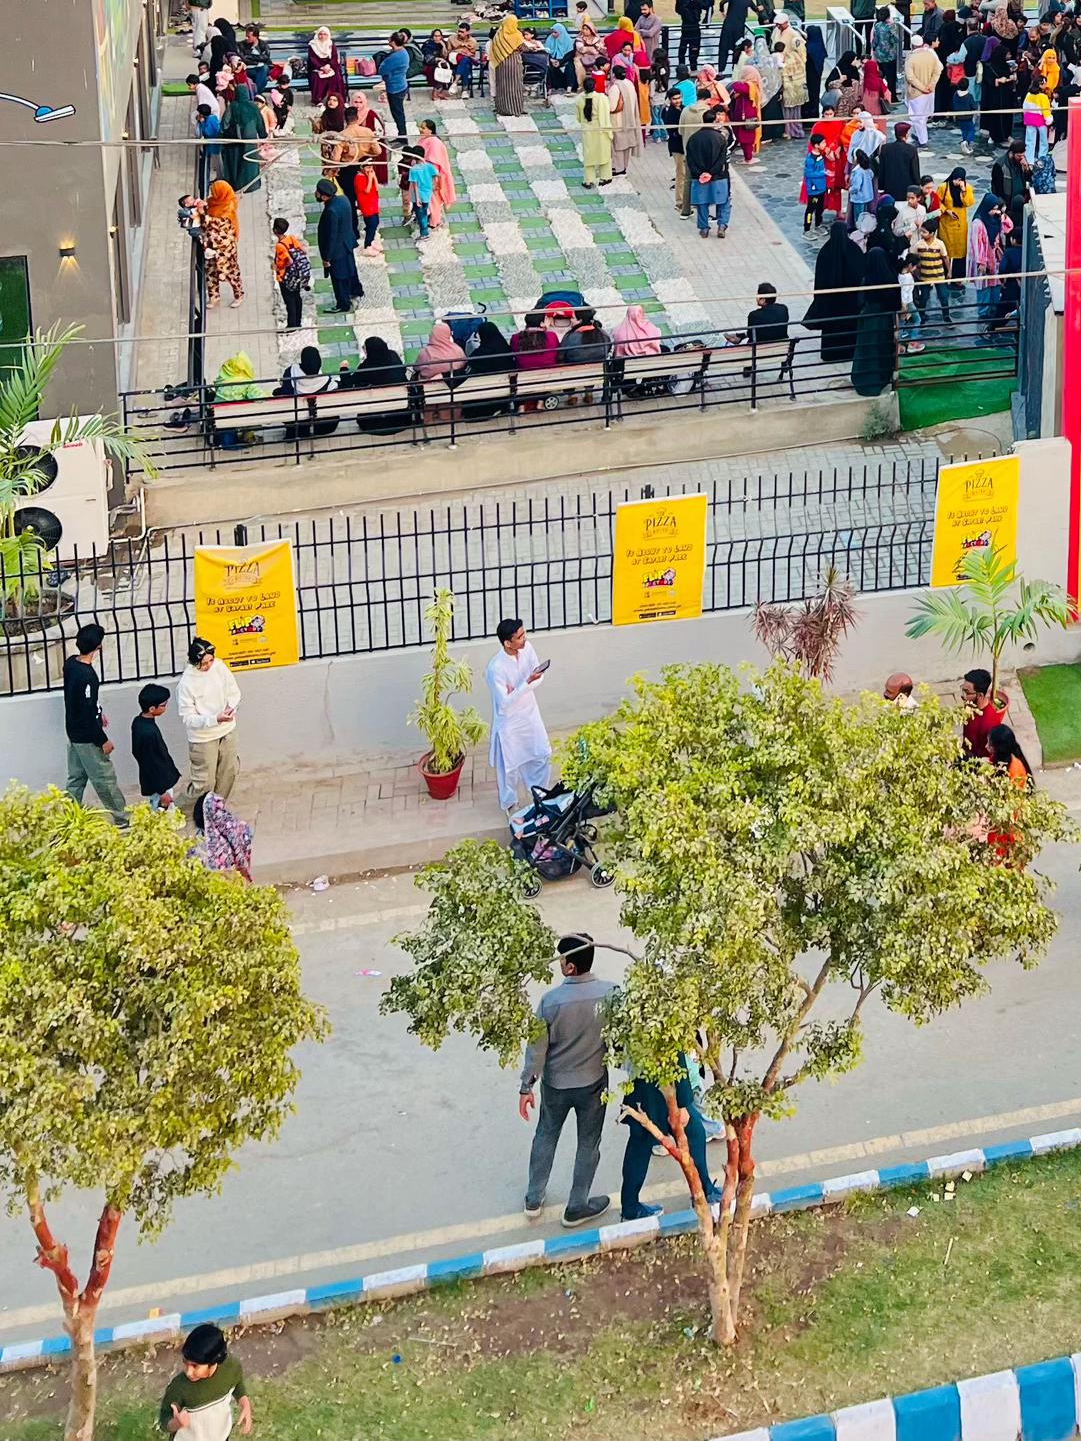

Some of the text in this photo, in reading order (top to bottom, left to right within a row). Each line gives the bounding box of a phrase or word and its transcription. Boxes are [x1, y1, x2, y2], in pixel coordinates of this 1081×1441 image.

[965, 478, 992, 492] PIZZA
[646, 517, 676, 531] PIZZA
[225, 561, 260, 576] PIZZA
